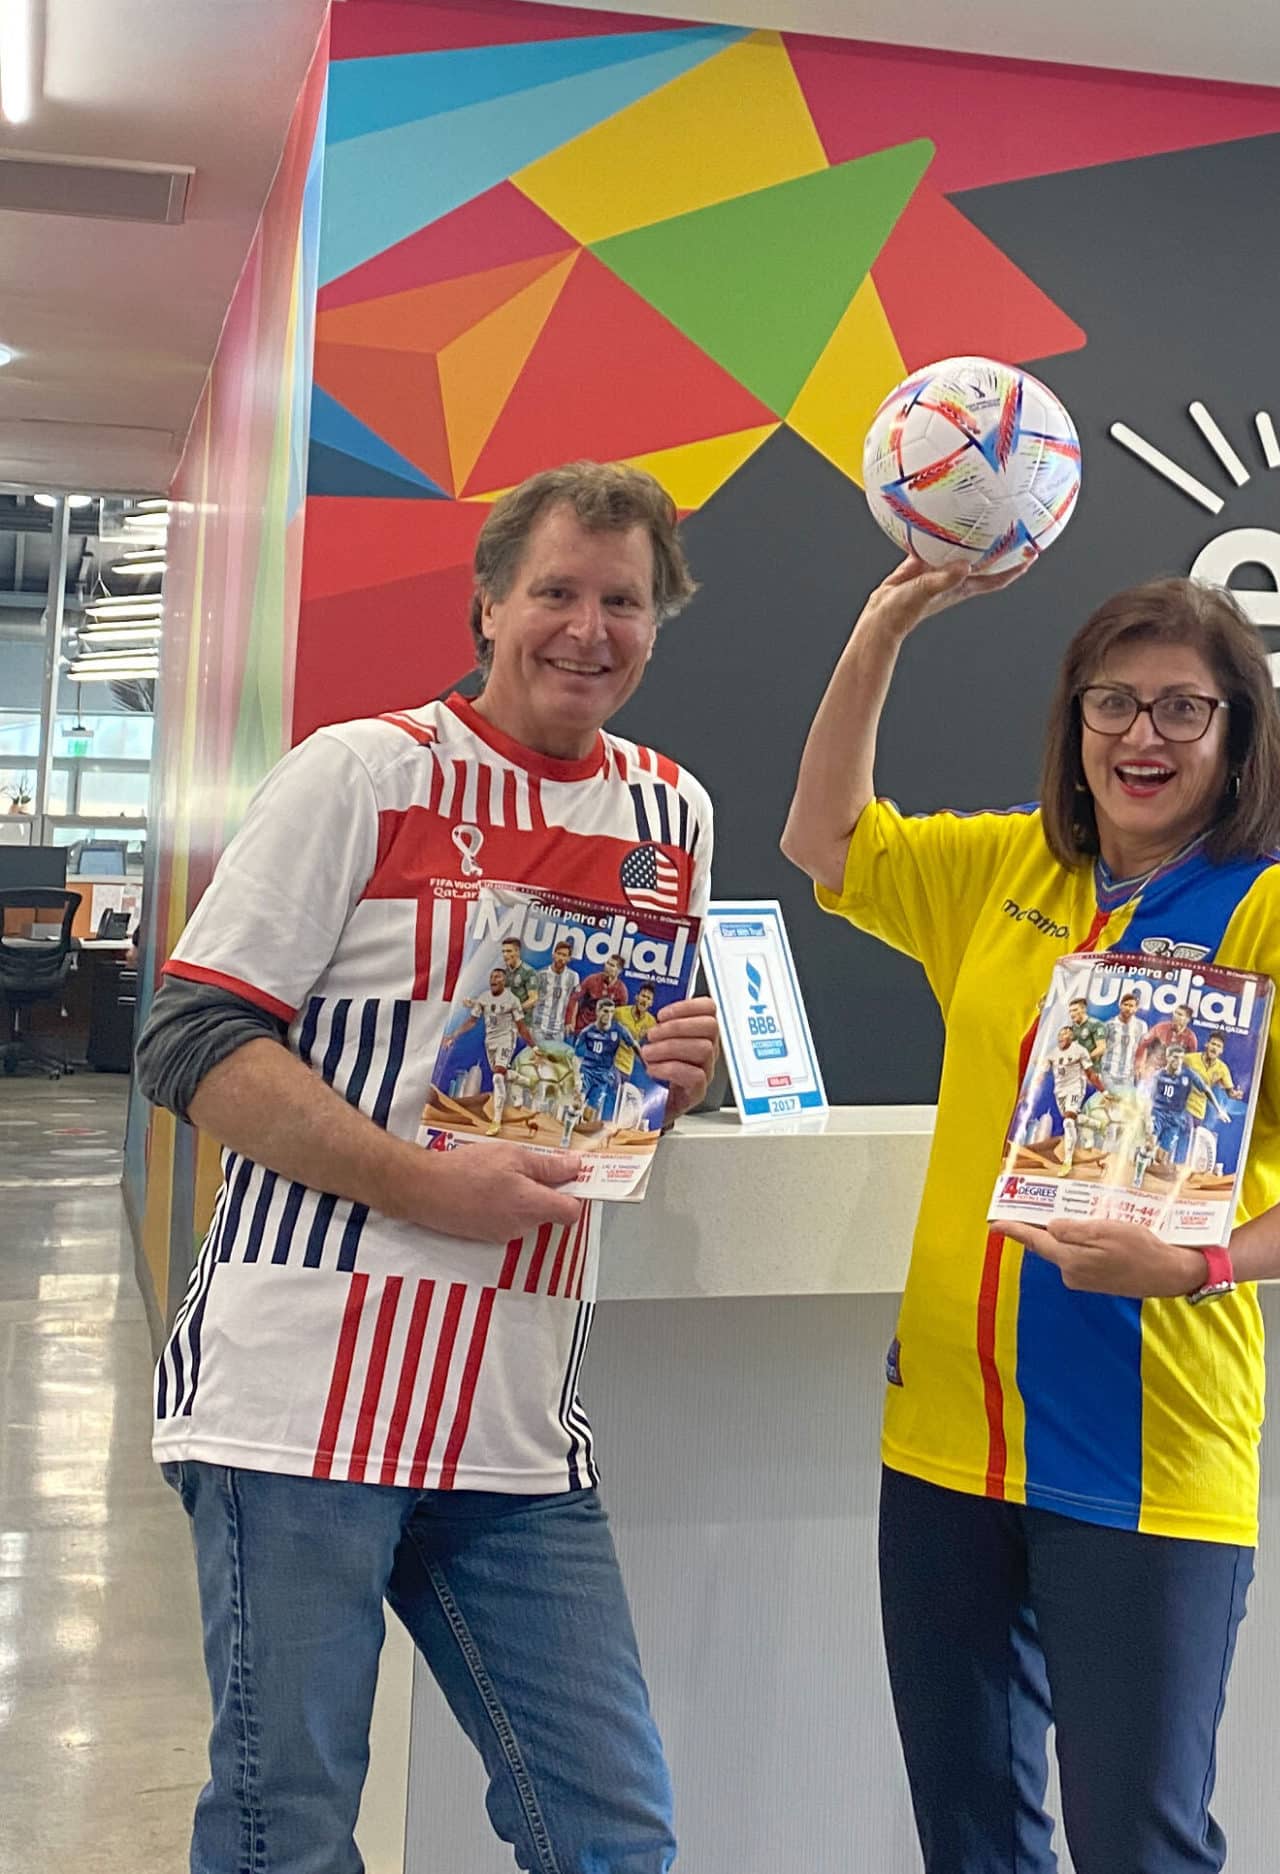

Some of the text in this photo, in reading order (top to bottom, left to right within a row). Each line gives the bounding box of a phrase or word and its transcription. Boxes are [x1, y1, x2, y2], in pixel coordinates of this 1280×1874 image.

[430, 878, 480, 890] FIFA WOR
[530, 900, 613, 929] Guía para el
[473, 899, 690, 979] Mundial
[1094, 960, 1126, 975] Guía
[1128, 964, 1163, 980] para
[1164, 969, 1179, 982] el
[1051, 965, 1257, 1029] Mundial
[748, 1016, 777, 1035] BBB
[772, 1099, 796, 1112] 2017
[1018, 1186, 1057, 1198] DEGREES
